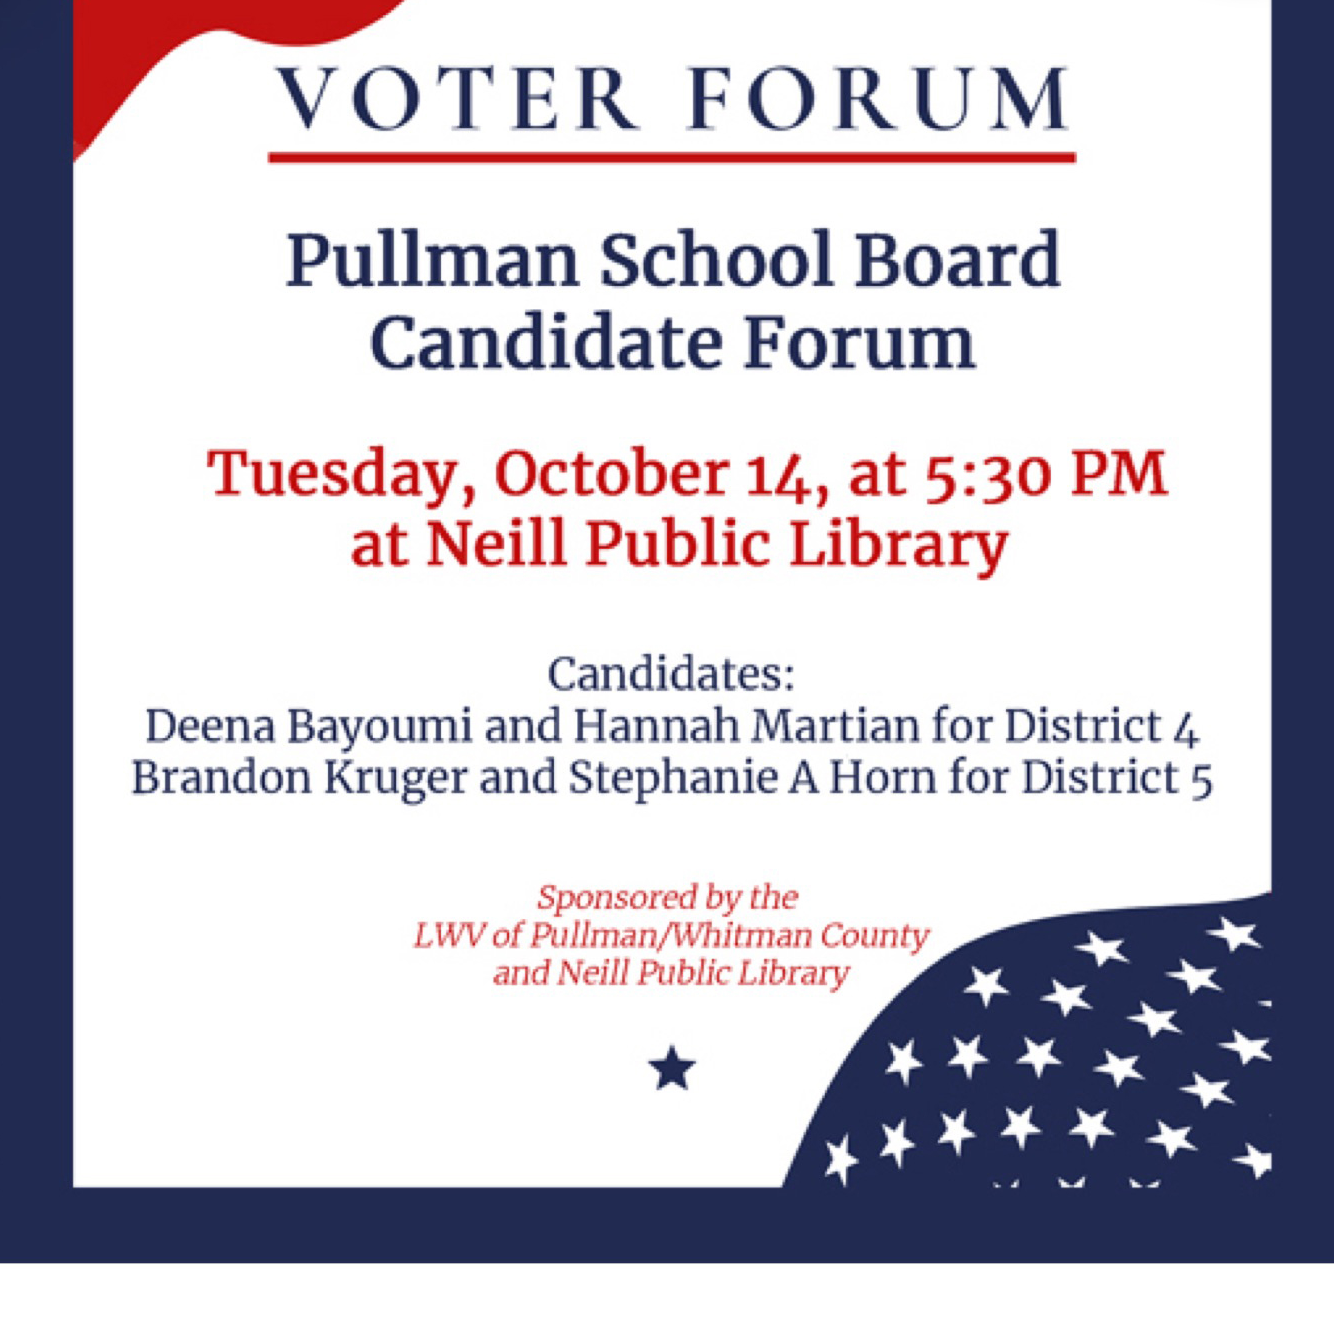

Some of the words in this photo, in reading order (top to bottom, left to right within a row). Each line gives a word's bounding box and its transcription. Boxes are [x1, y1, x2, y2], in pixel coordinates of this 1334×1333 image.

[287, 228, 580, 286] Pullman
[602, 228, 834, 286] School
[856, 228, 1061, 286] Board
[207, 446, 475, 509] Tuesday,
[496, 446, 730, 496] October
[748, 454, 827, 508] 14,
[850, 452, 906, 496] at
[927, 457, 1051, 504] 5:30
[1072, 449, 1169, 495] PM
[147, 709, 274, 742] Deena
[289, 707, 472, 753] Bayoumi
[486, 706, 561, 742] and
[575, 706, 739, 742] Hannah
[752, 707, 919, 742] Martian
[934, 704, 993, 742] for
[1006, 707, 1161, 742] District
[1174, 712, 1199, 749] 4
